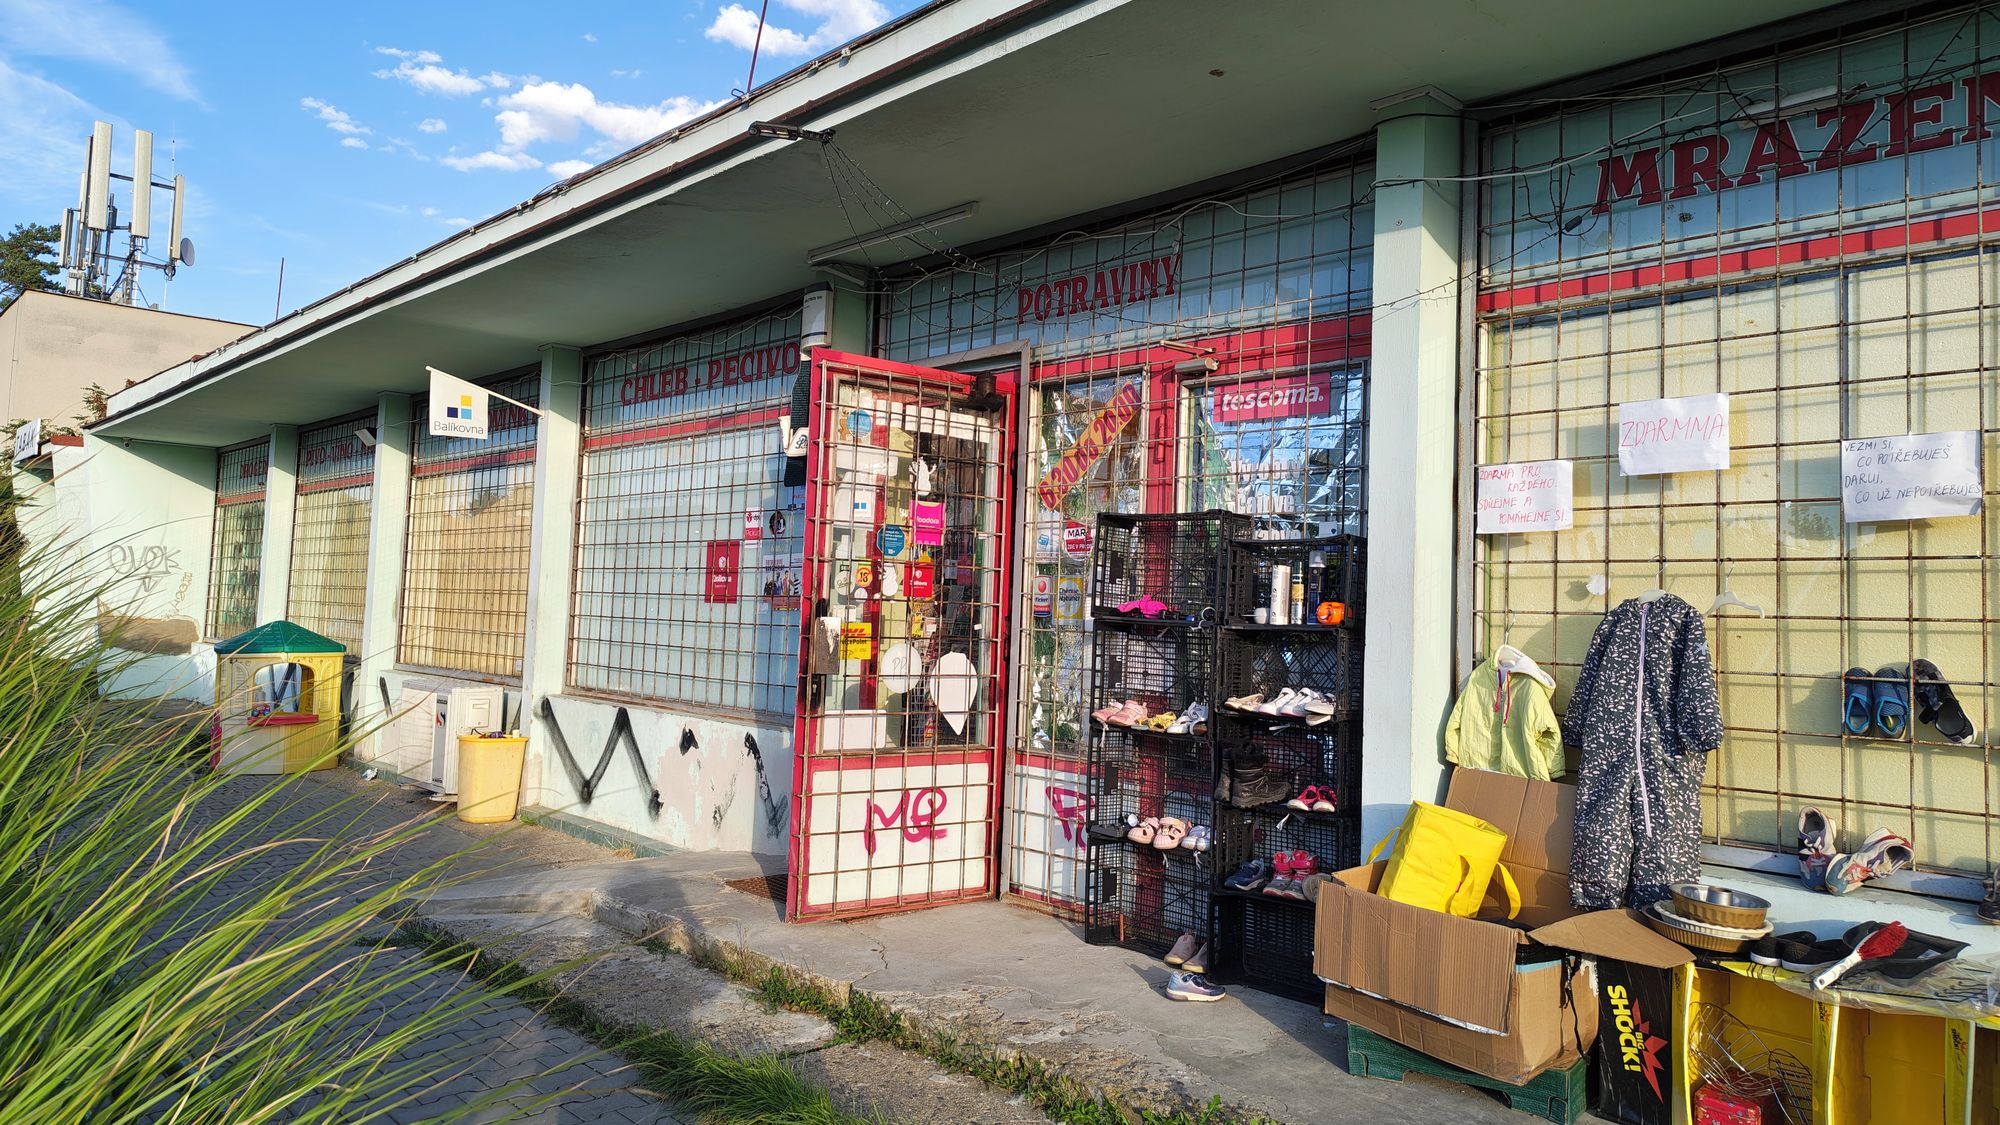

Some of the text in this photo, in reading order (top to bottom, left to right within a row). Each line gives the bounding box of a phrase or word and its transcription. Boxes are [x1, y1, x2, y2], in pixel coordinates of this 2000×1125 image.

[1018, 254, 1182, 325] POTRAVINY
[433, 421, 485, 435] Balíkovna
[1620, 412, 1726, 448] ZDARMMA
[1844, 440, 1877, 453] VEZMI
[1856, 455, 1872, 468] CO
[1479, 466, 1541, 481] ZDARMA PRO
[1523, 496, 1532, 507] A
[1854, 490, 1870, 504] CO
[1876, 487, 1891, 501] UŽ
[1607, 984, 1642, 1073] SHOCK!
[1634, 1031, 1646, 1051] BIG
